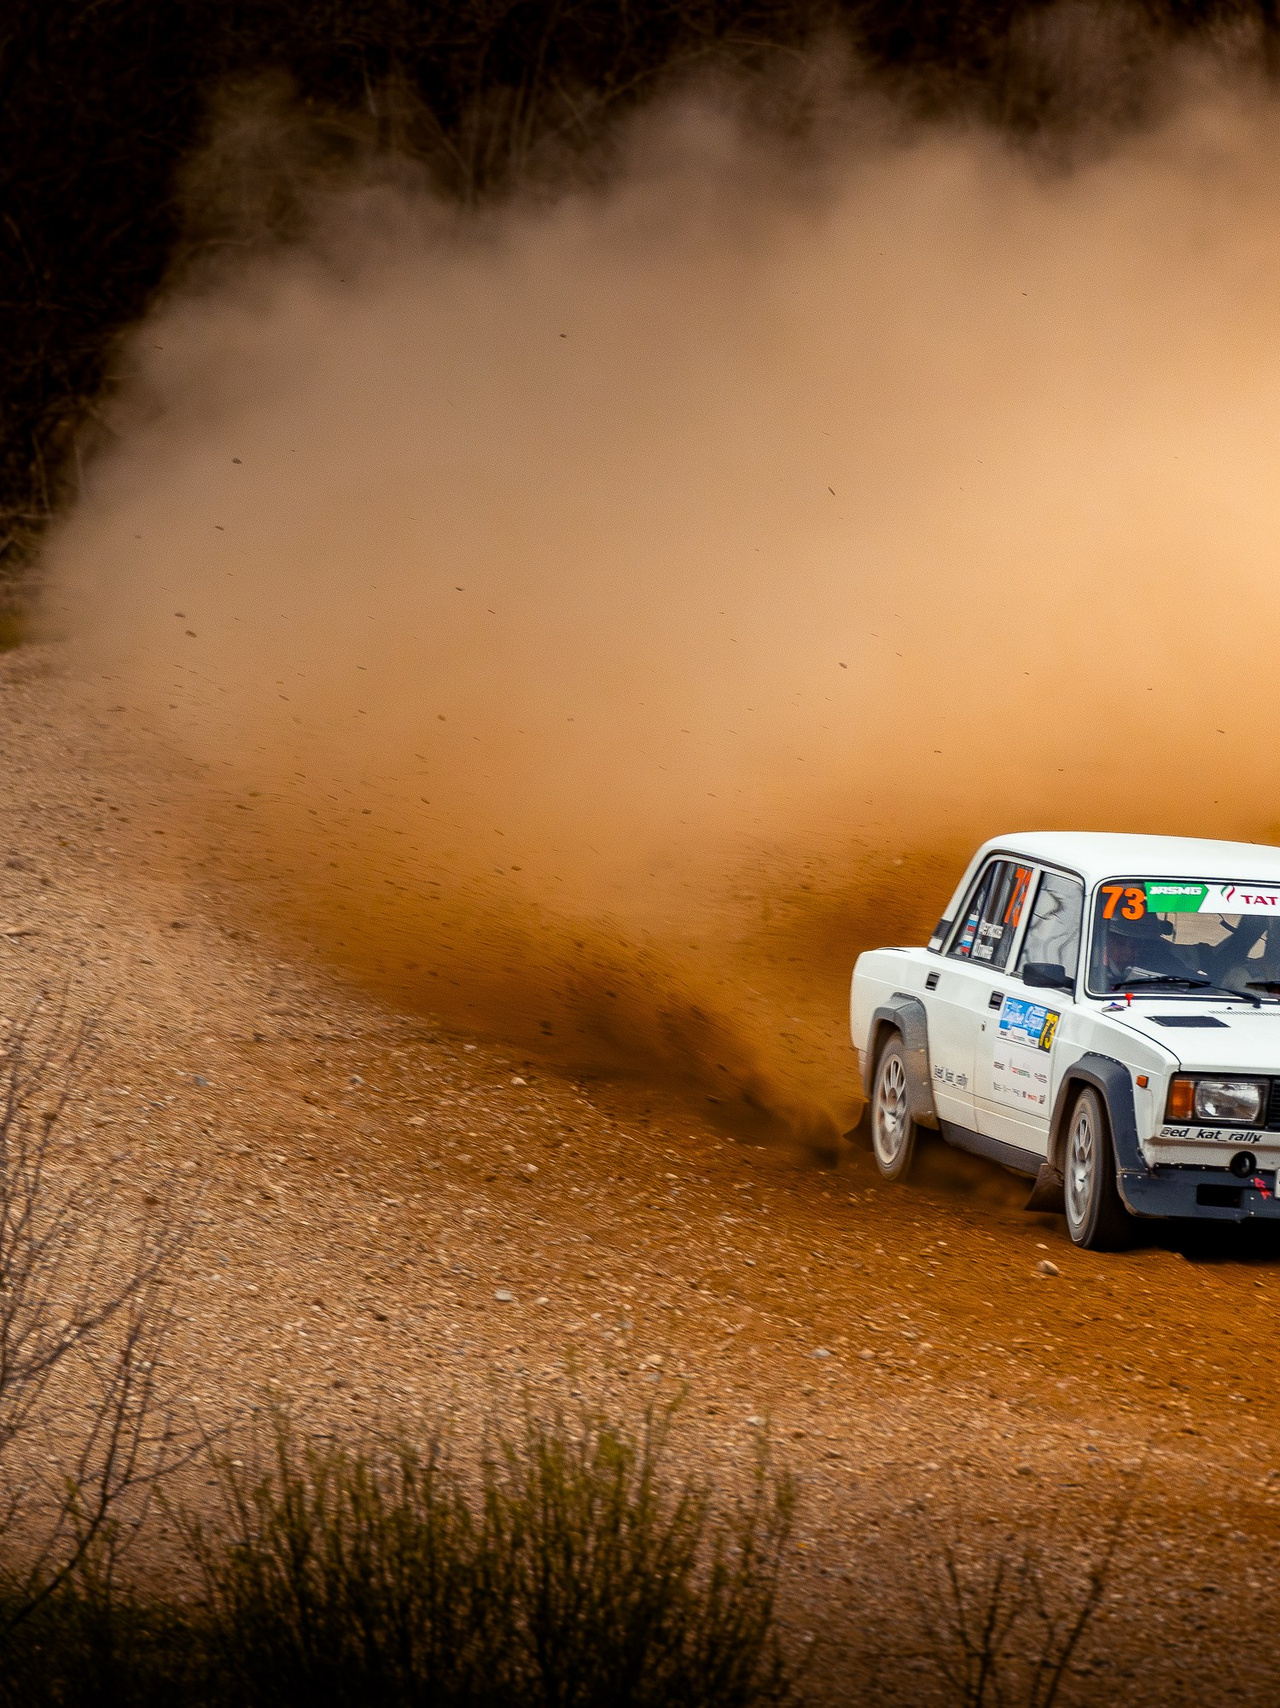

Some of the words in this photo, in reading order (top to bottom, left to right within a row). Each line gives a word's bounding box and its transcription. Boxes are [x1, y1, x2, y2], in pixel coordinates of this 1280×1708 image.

[1101, 886, 1145, 920] 73
[1039, 1013, 1059, 1049] 73
[1160, 1126, 1262, 1144] @ed_kat_rally
